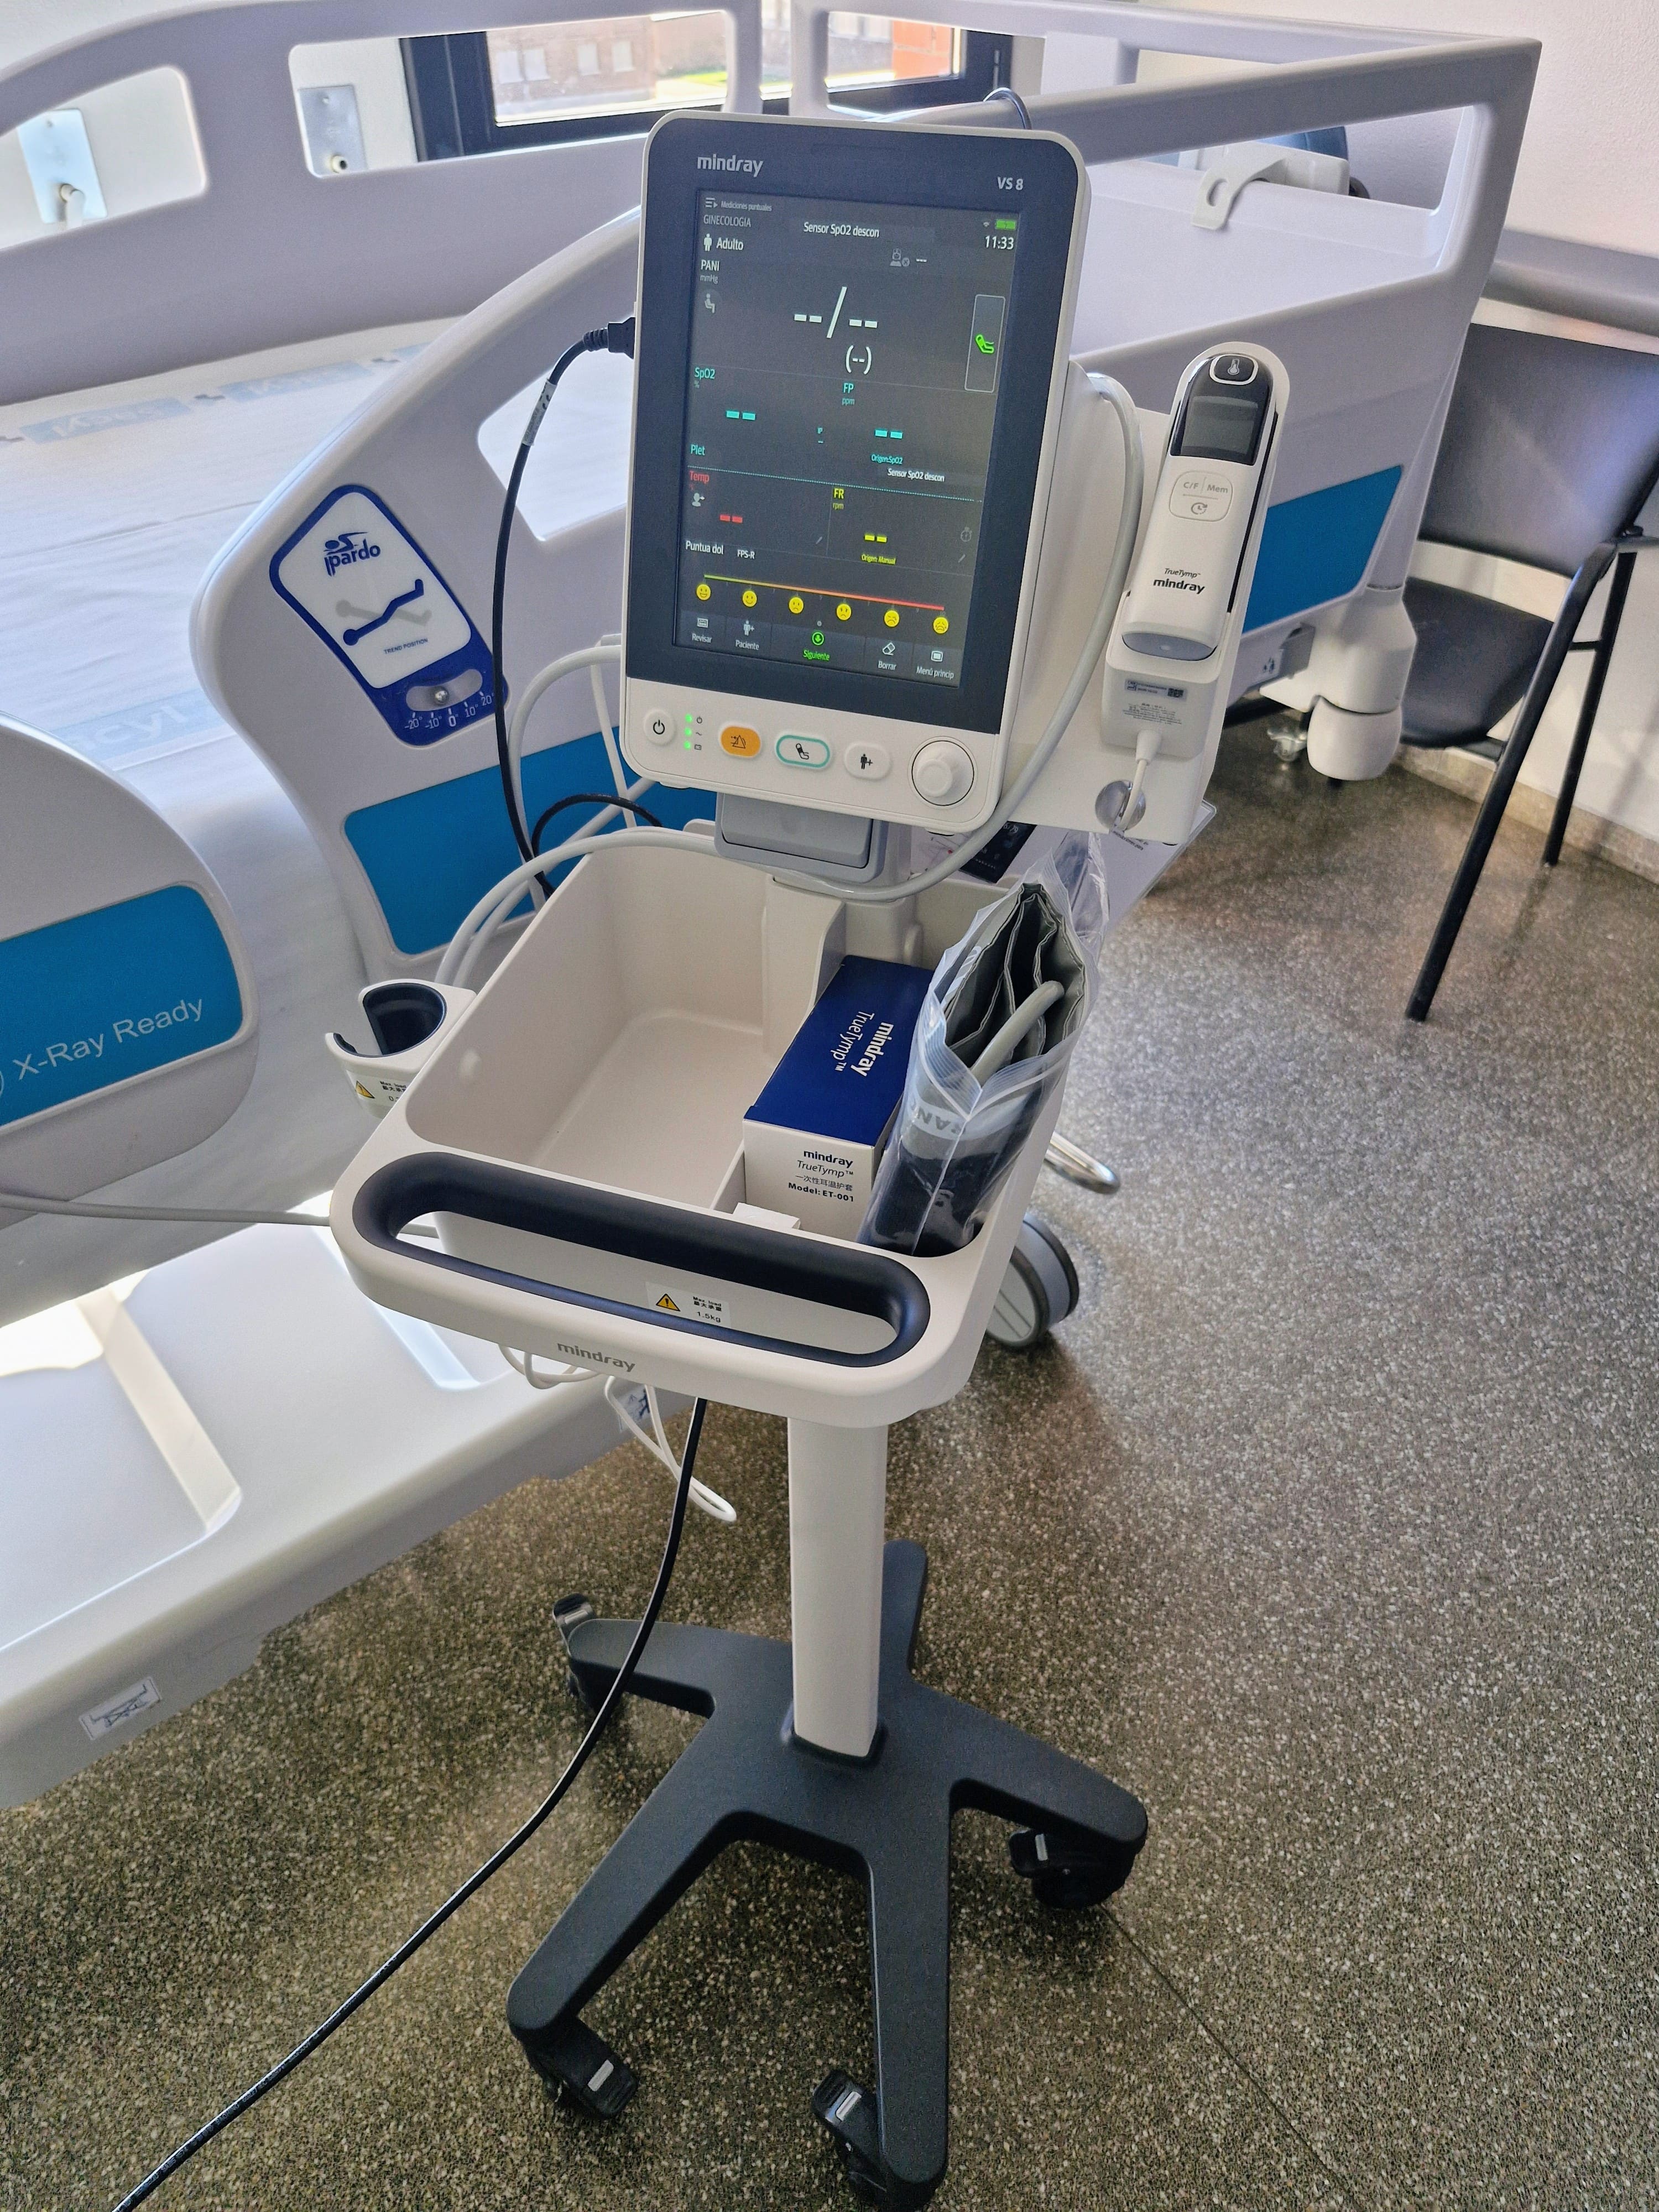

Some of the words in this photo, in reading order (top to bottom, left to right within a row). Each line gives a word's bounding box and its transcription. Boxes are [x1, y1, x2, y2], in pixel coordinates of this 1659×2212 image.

[697, 154, 763, 177] mindray
[997, 176, 1013, 190] VS
[1015, 178, 1024, 191] 8
[721, 200, 747, 210] Mediciones
[748, 203, 772, 212] puntuales
[703, 215, 751, 227] GINECOLOGIA
[804, 222, 830, 234] Sensor
[852, 225, 879, 238] descon
[717, 237, 744, 251] Adulto
[984, 236, 1014, 250] 11:33
[701, 259, 720, 272] PANI
[700, 274, 718, 284] mmHg
[843, 383, 854, 394] FP
[842, 398, 855, 406] ppm
[691, 444, 706, 456] Plet
[690, 471, 710, 484] Temp
[888, 468, 907, 478] Sensor
[924, 471, 945, 482] descon
[833, 488, 844, 499] FR
[1207, 484, 1228, 494] Mem
[686, 540, 711, 554] Puntua
[712, 545, 724, 555] dol
[737, 549, 755, 560] FPS-R
[878, 556, 896, 565] Manual
[1153, 578, 1206, 594] mindray
[692, 633, 712, 643] Revisar
[384, 645, 403, 654] TREND
[403, 638, 428, 649] POSITION
[735, 640, 760, 650] Paciente
[803, 649, 830, 661] Siguiente
[878, 660, 897, 670] Borrar
[916, 666, 933, 676] Menú
[933, 669, 954, 680] princip
[13, 1034, 104, 1081] X-Ray
[113, 999, 203, 1043] Ready
[851, 1022, 894, 1077] mindray
[804, 1151, 853, 1168] mindray
[795, 1175, 853, 1192] 一次性耳温护套
[788, 1182, 821, 1195] Model:
[822, 1190, 853, 1202] ET-001
[697, 1311, 721, 1323] 1.5kg
[557, 1342, 636, 1373] mindray
